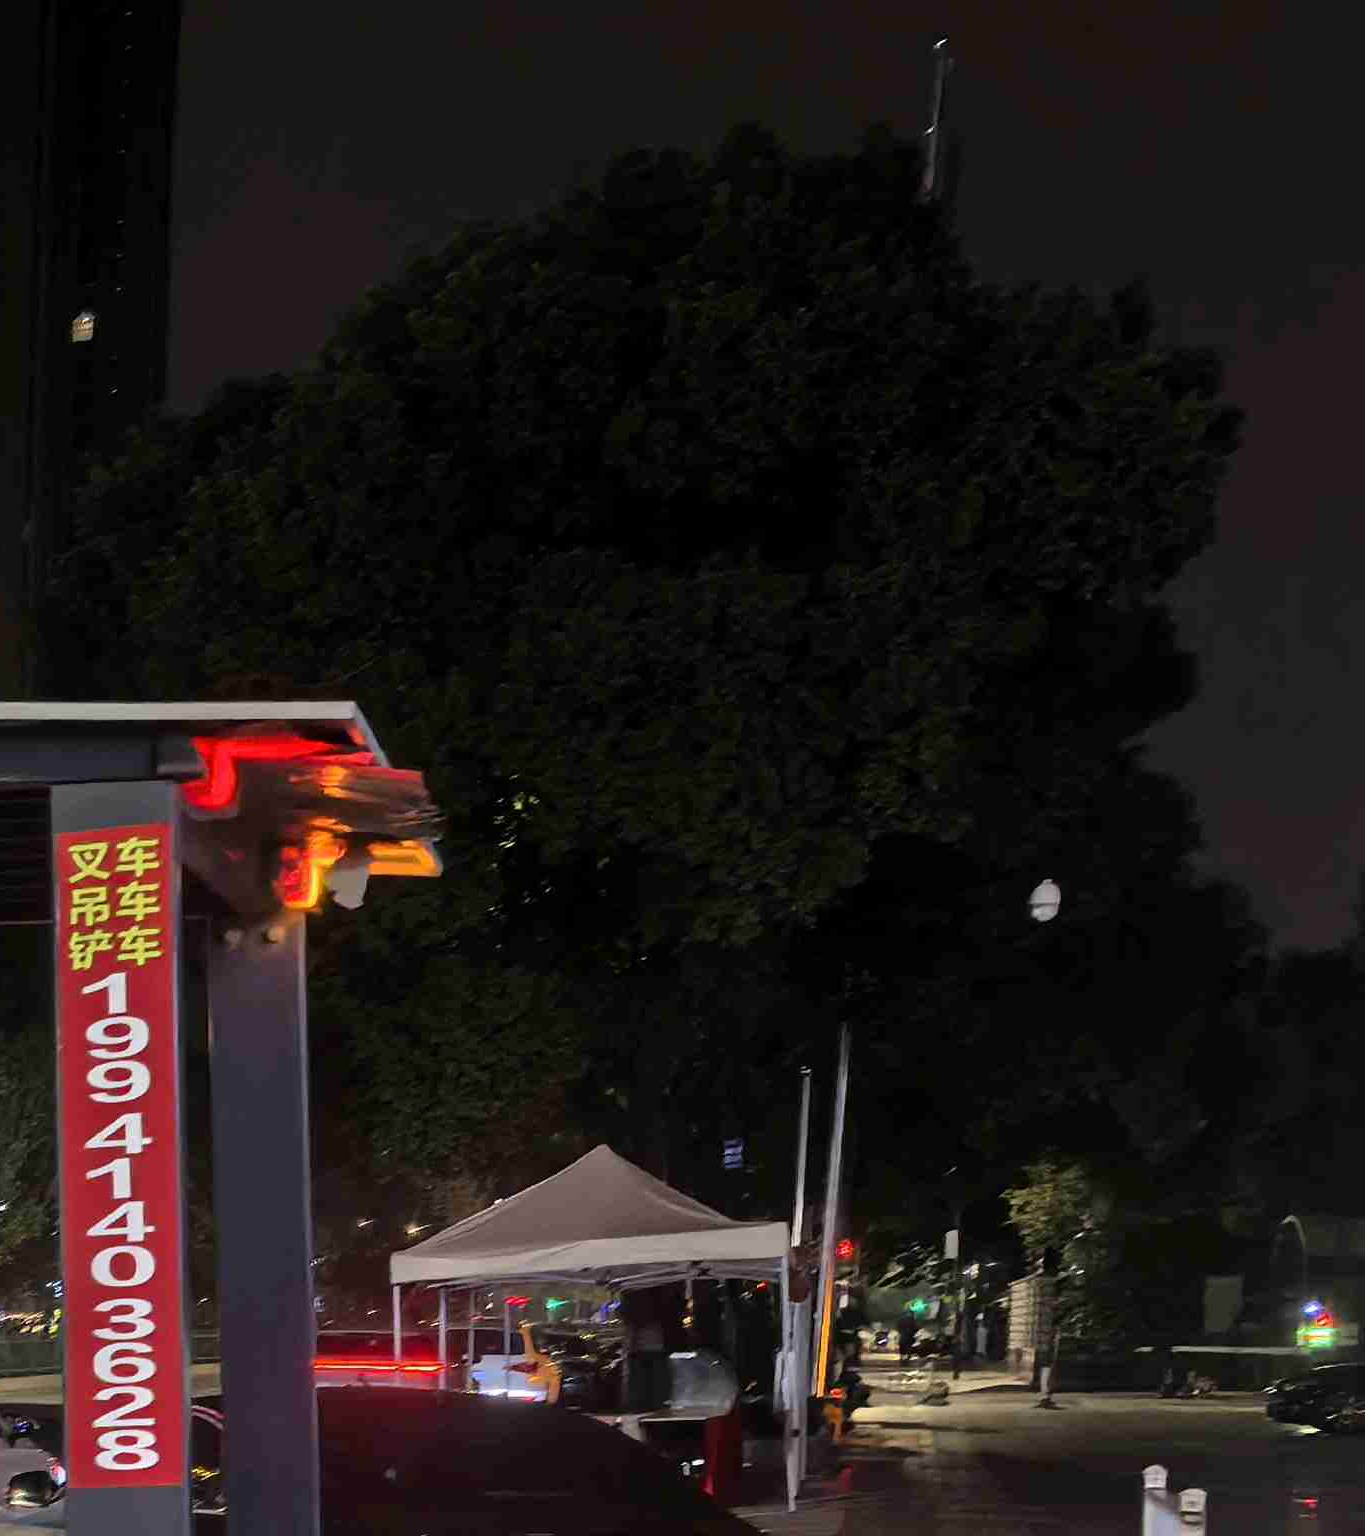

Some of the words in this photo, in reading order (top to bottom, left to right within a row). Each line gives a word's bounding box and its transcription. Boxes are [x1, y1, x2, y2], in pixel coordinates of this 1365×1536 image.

[68, 836, 162, 885] 叉车
[68, 880, 162, 928] 吊车
[68, 924, 163, 971] 铲车
